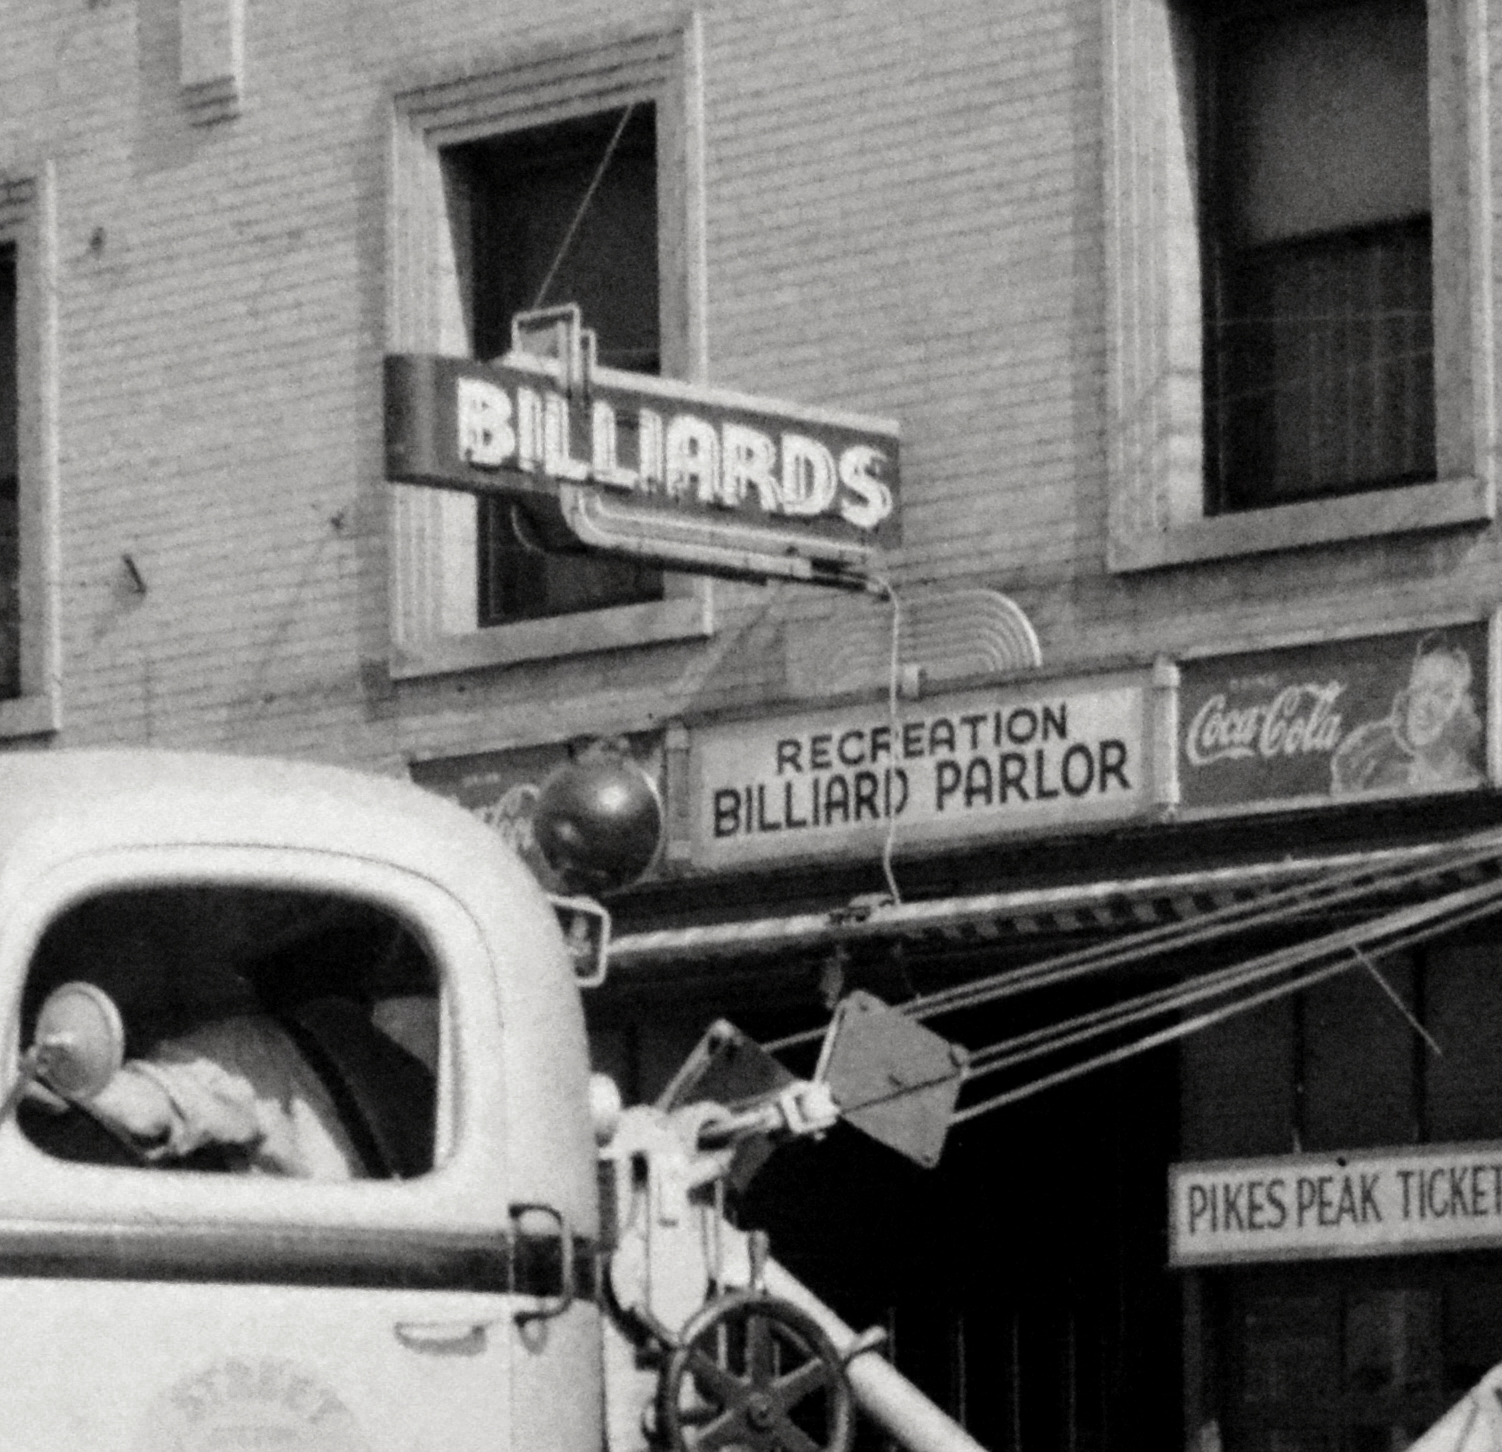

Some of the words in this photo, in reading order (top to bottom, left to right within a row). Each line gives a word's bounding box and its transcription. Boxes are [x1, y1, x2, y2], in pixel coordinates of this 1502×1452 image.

[457, 377, 893, 530] BILLIARDS
[776, 702, 1068, 776] RECREATION
[1187, 679, 1348, 767] Coca-Cola
[713, 768, 910, 838] BILLIARD
[935, 738, 1132, 812] PARLOR
[1187, 1177, 1286, 1235] PIKES
[1297, 1172, 1382, 1228] PEAK
